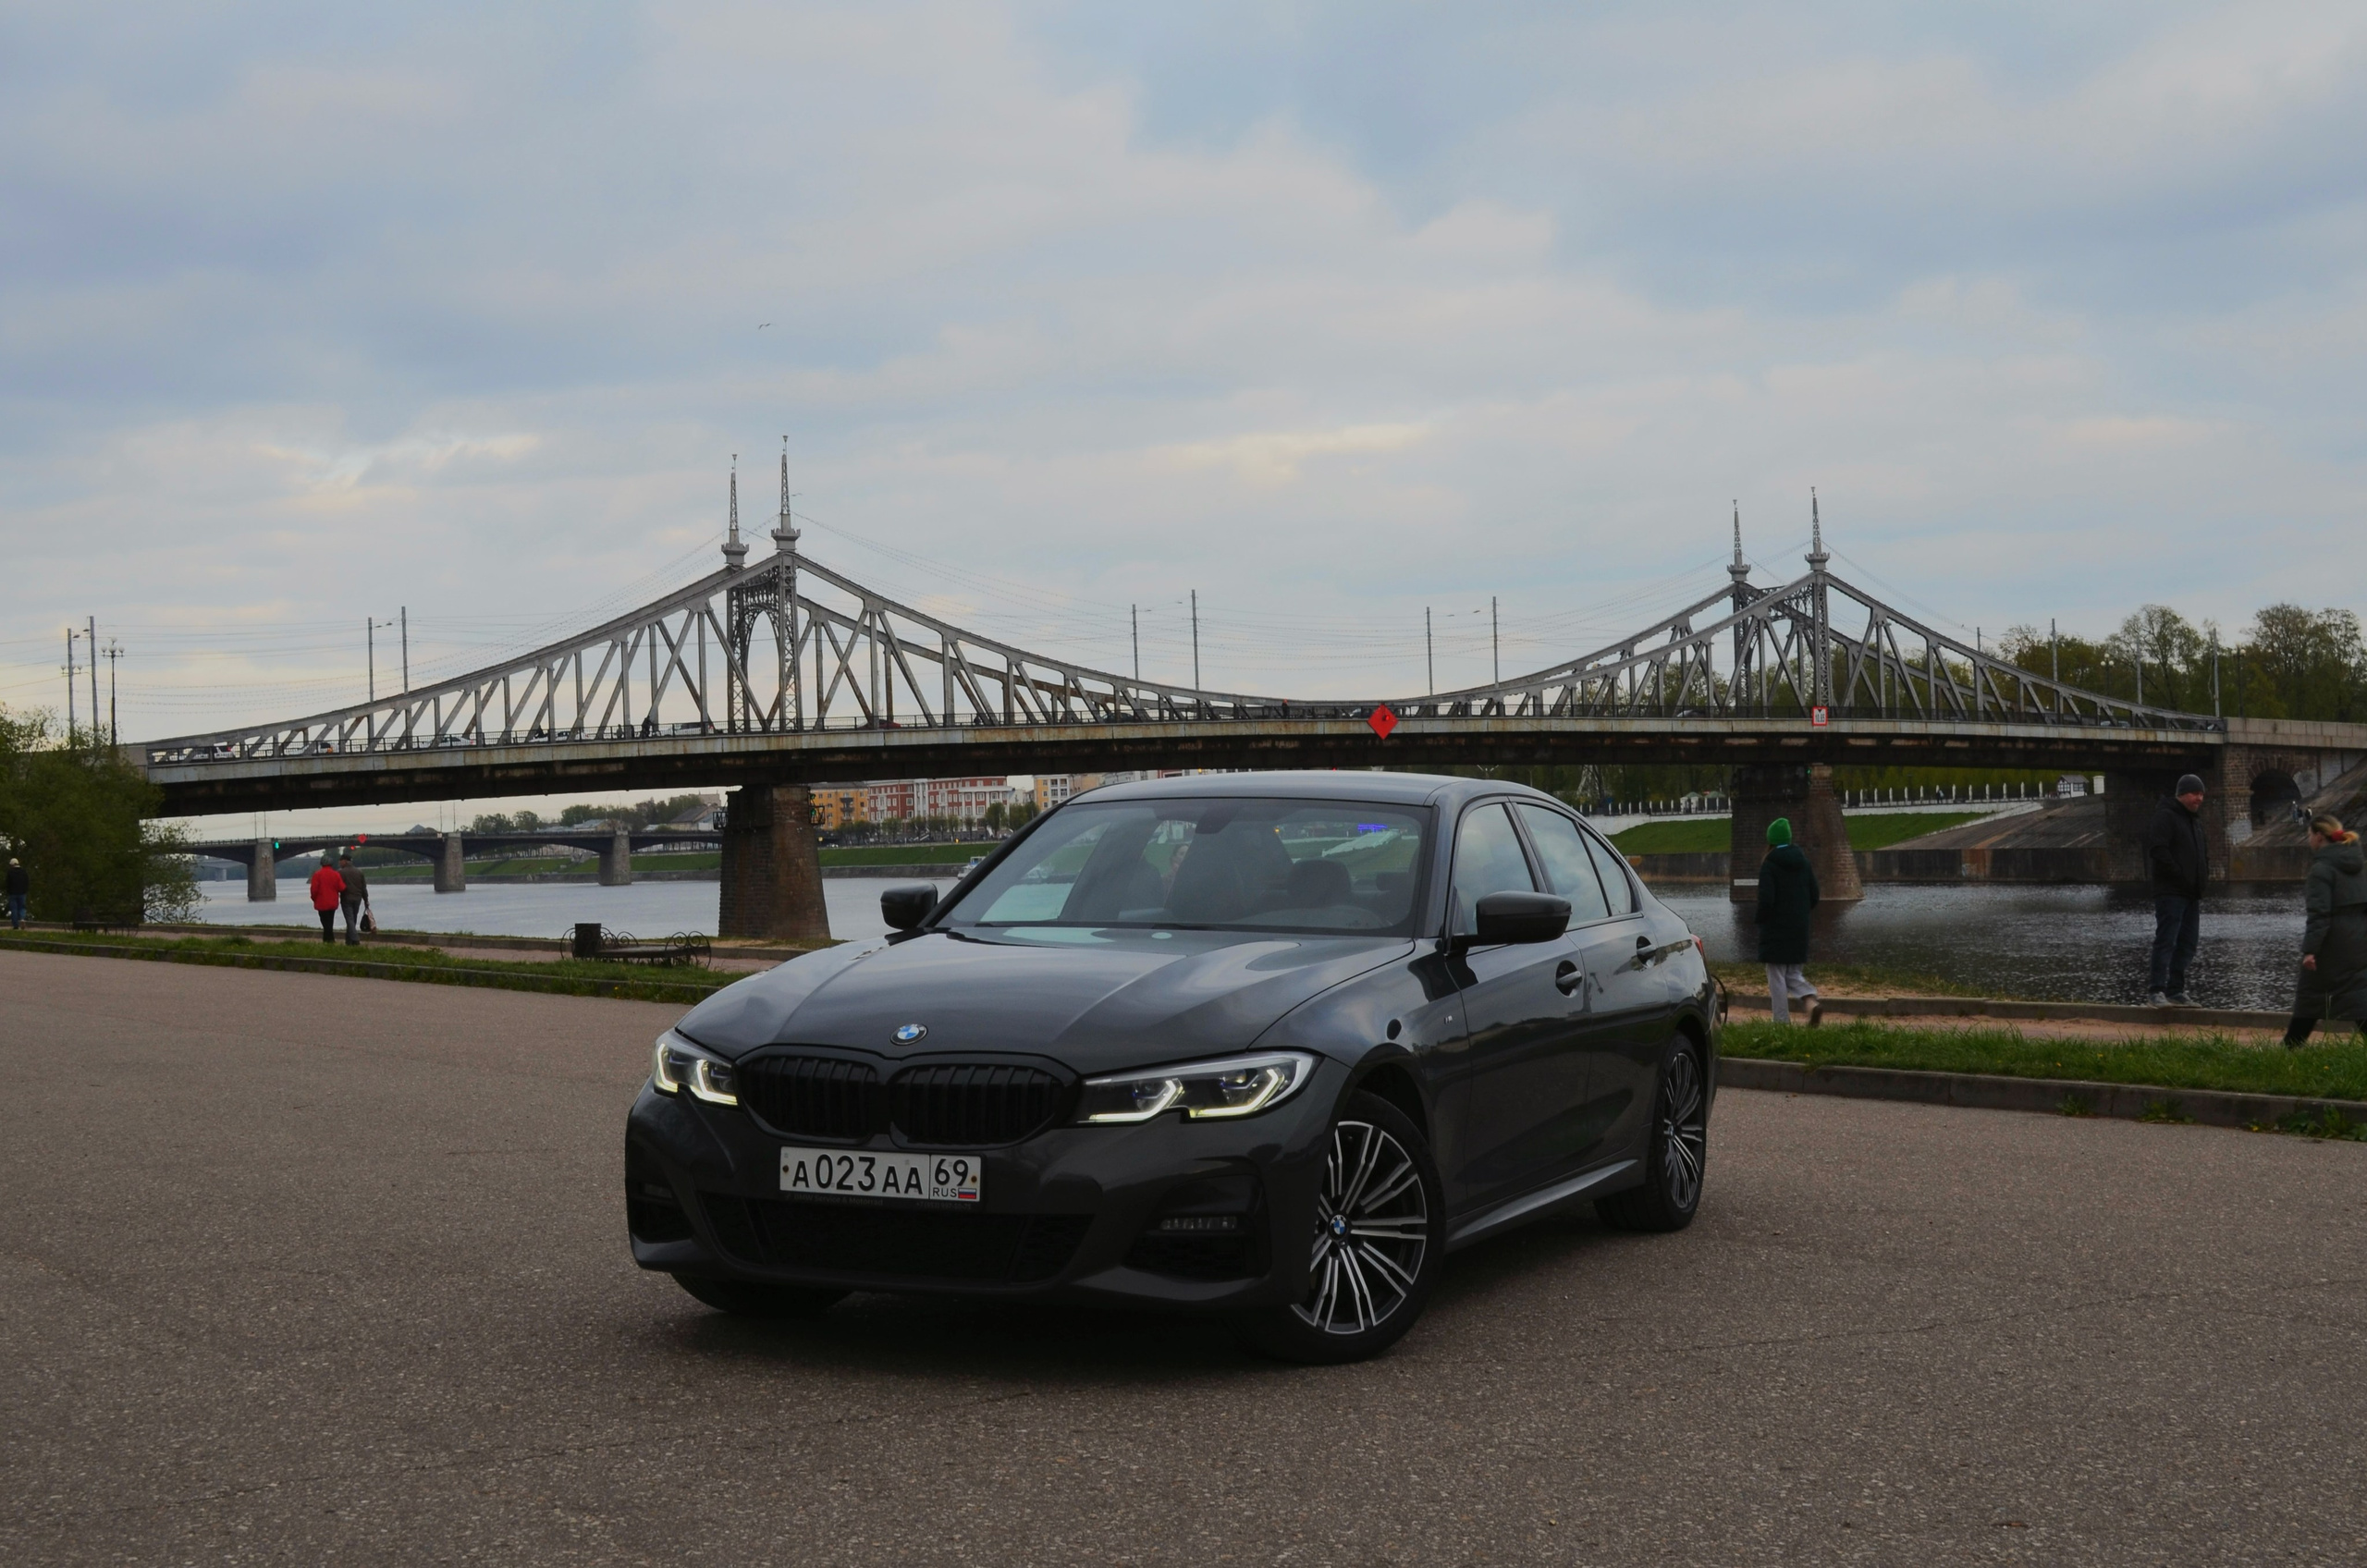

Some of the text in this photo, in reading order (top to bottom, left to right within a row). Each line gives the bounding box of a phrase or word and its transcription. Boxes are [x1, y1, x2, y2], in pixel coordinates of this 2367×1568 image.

[934, 1158, 969, 1186] 69
[932, 1187, 957, 1198] RUS
[849, 1197, 883, 1206] Motorrad
